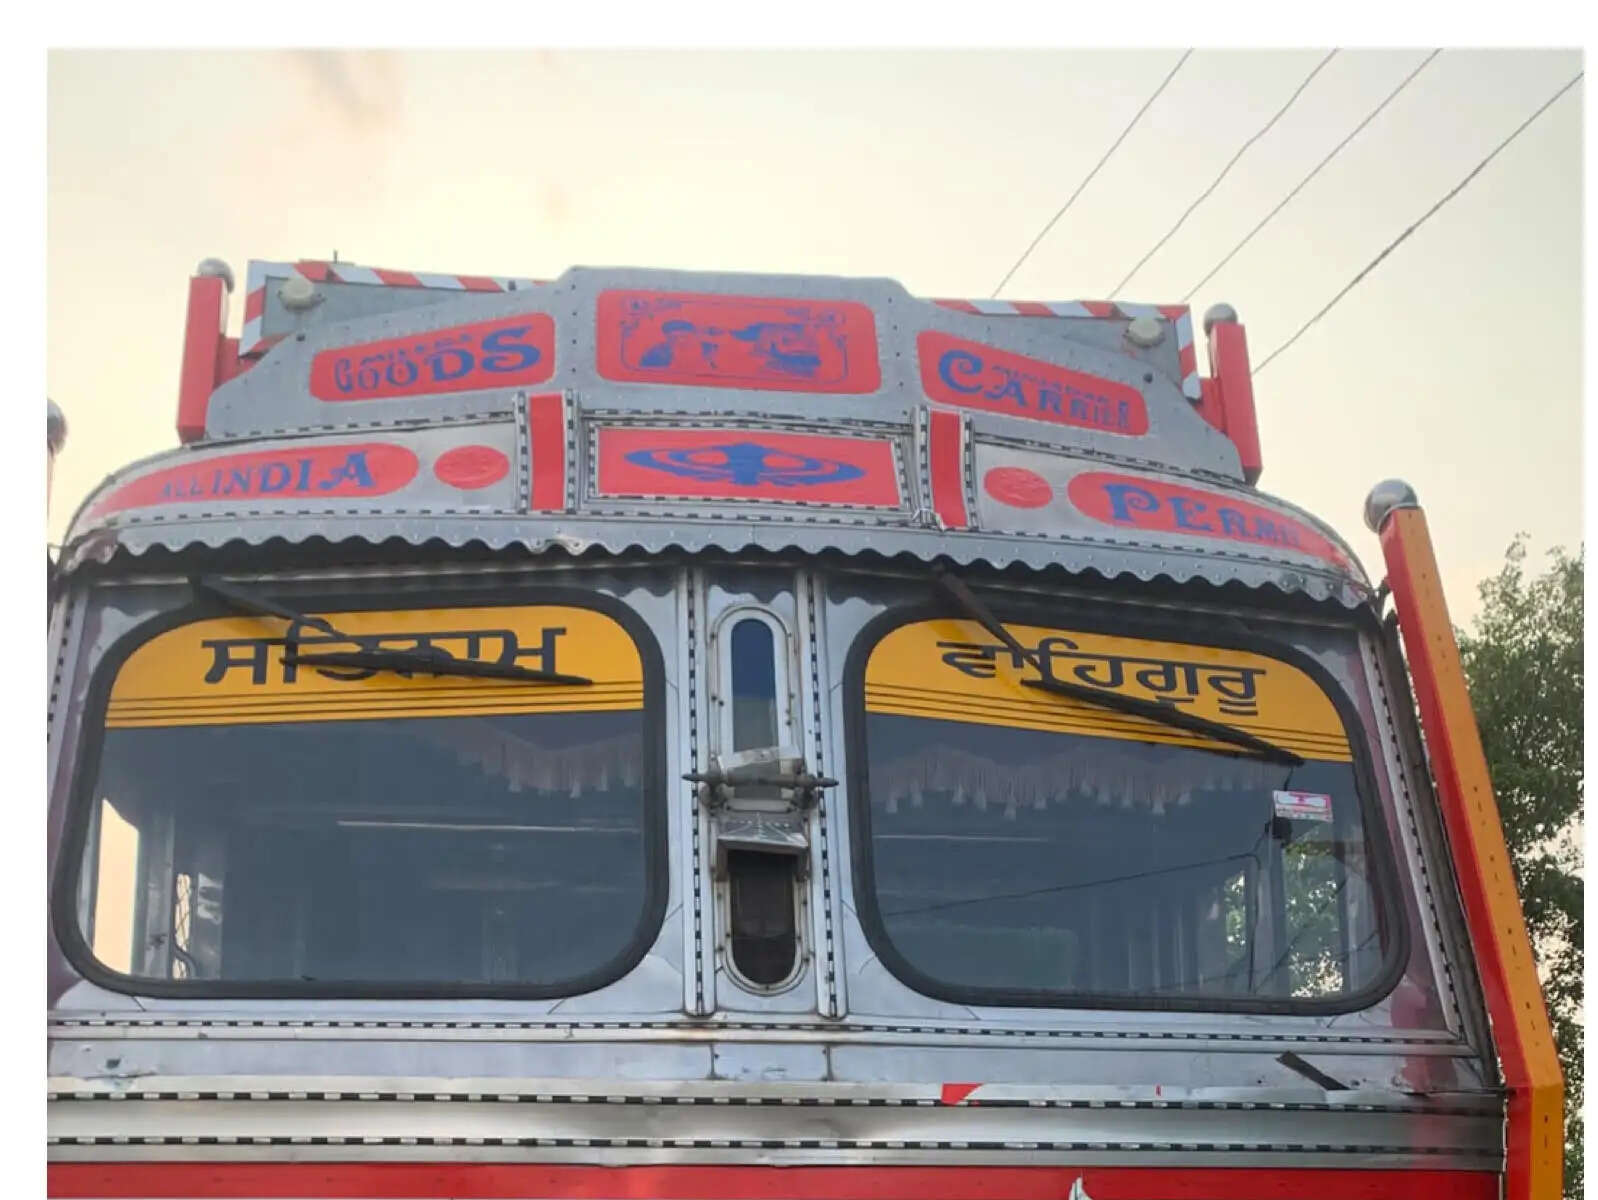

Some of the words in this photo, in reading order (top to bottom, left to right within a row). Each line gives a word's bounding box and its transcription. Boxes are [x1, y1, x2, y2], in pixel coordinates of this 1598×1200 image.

[334, 325, 541, 393] GOODS
[158, 474, 203, 498] ALL
[211, 451, 376, 496] INDIA
